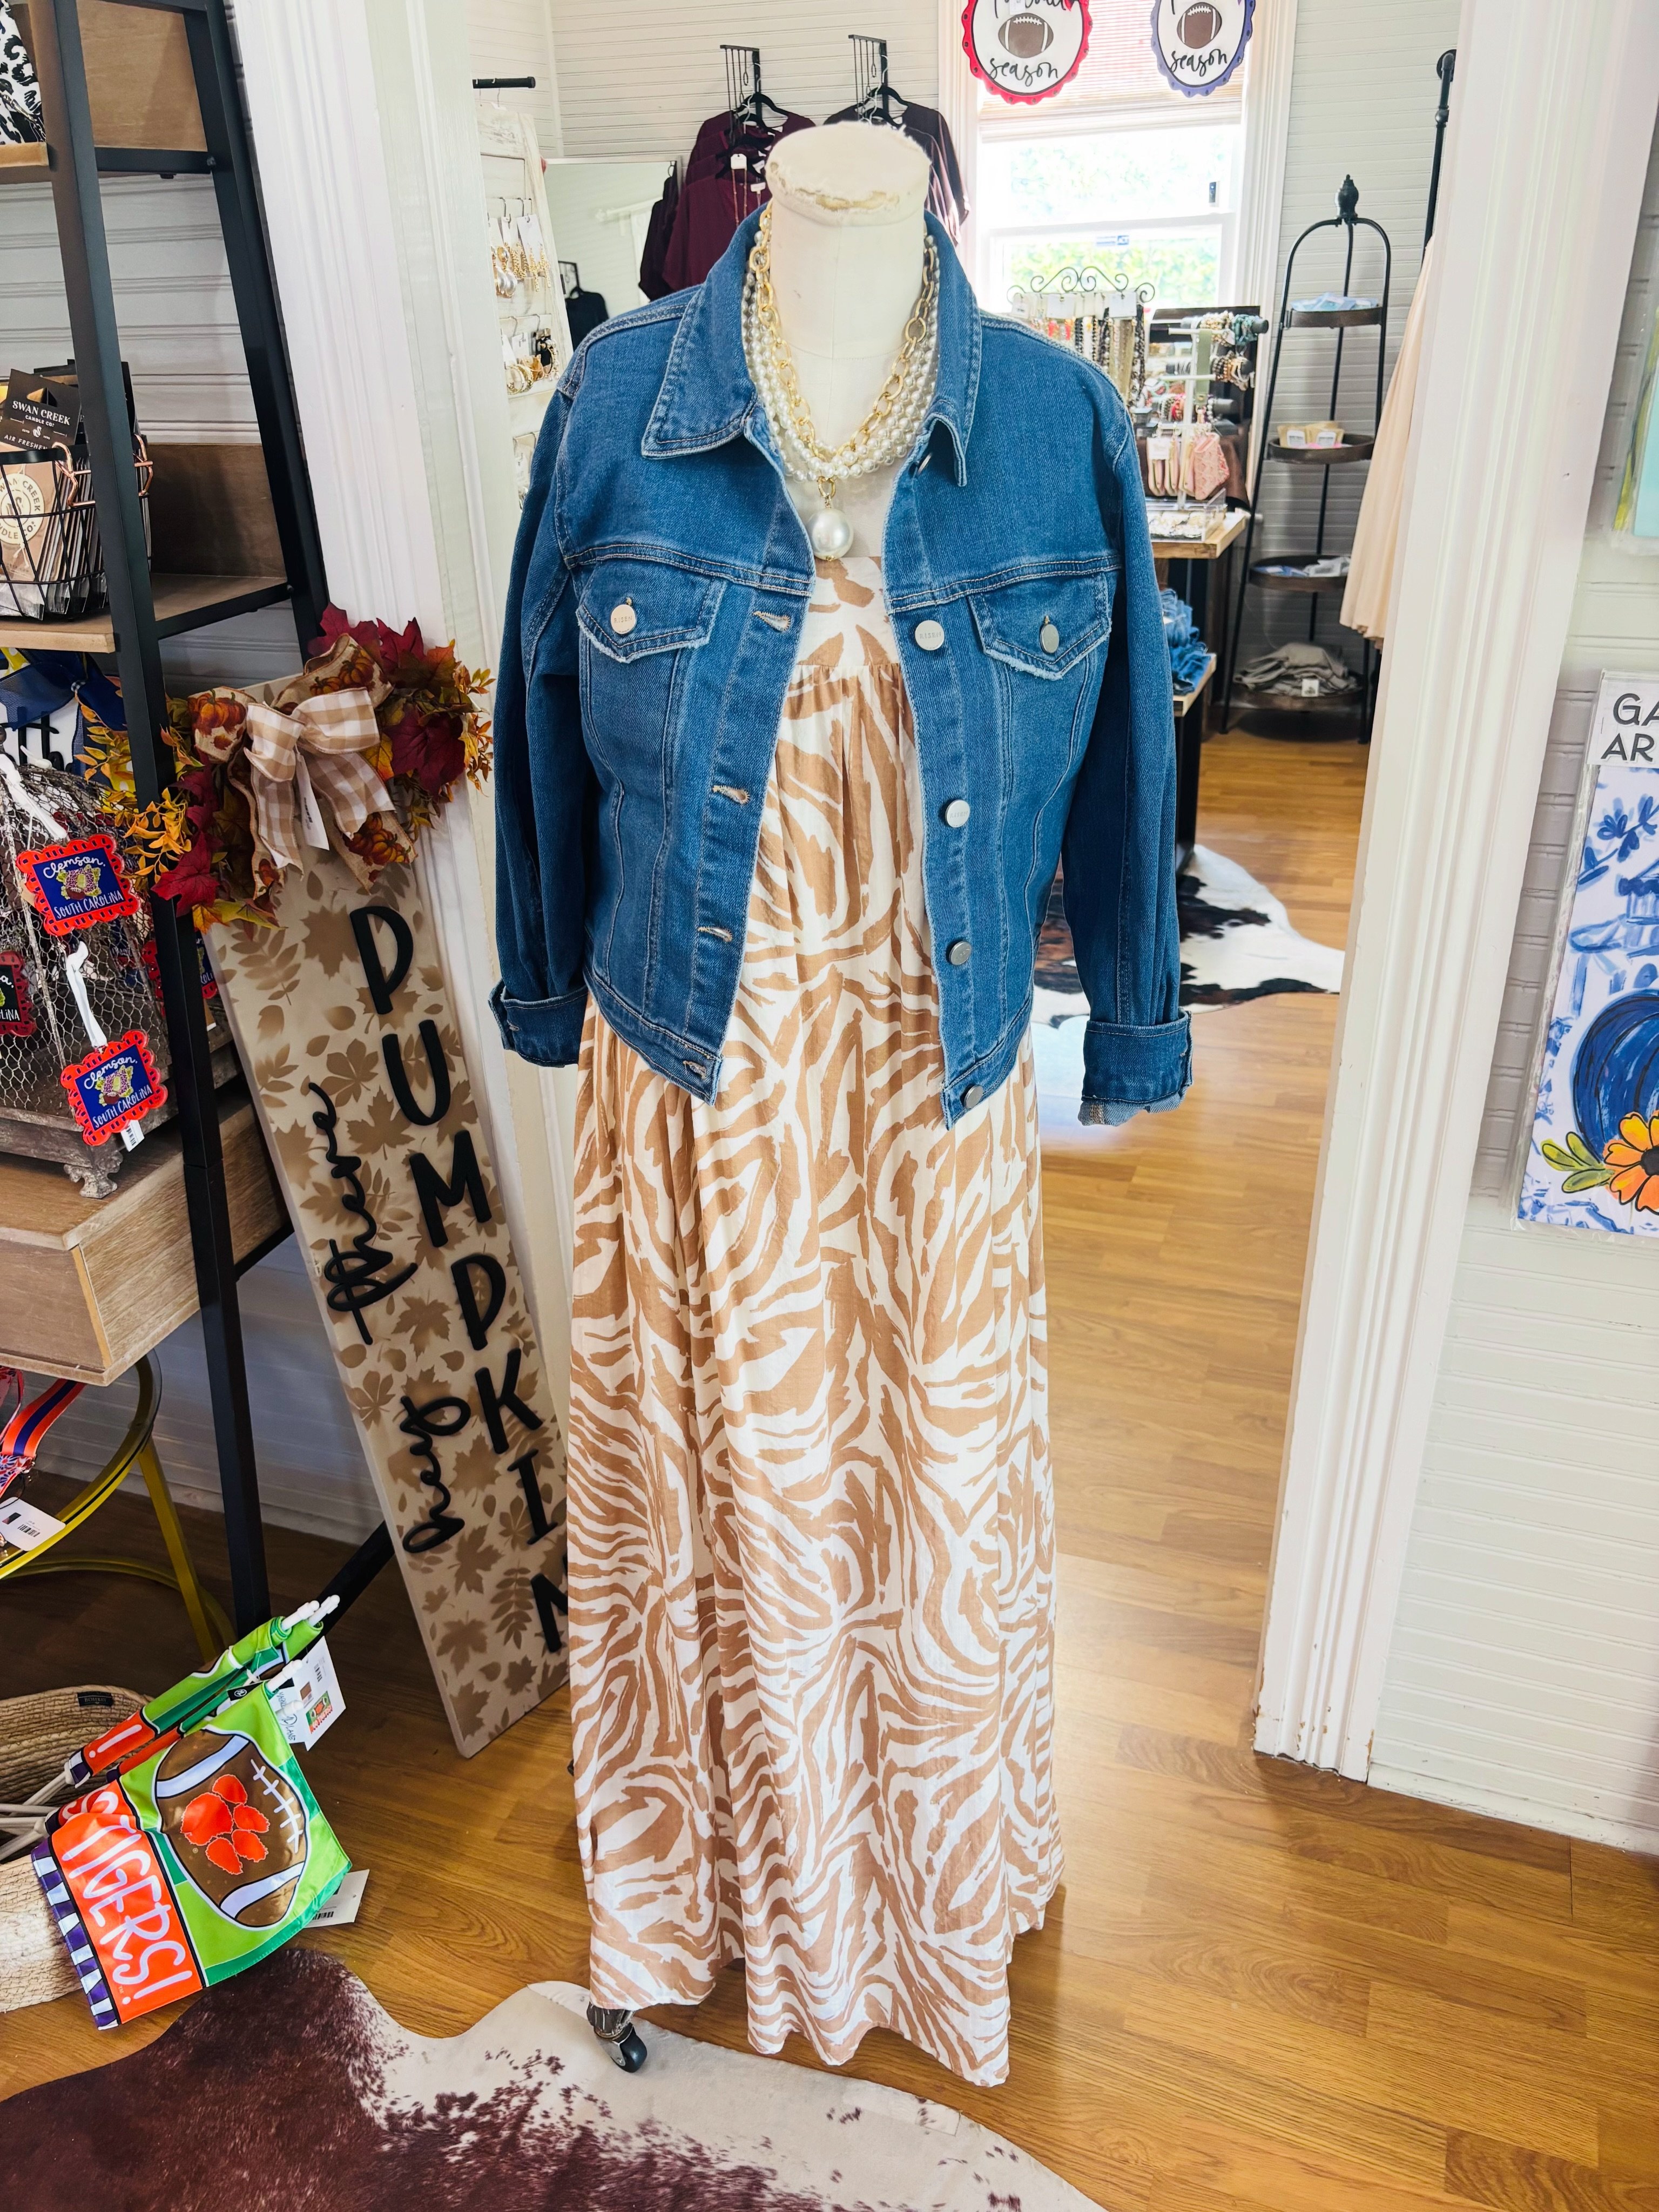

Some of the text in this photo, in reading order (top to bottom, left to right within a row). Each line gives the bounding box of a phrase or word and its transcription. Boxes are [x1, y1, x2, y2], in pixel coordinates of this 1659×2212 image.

[989, 57, 1058, 86] season
[1169, 48, 1228, 76] season
[12, 401, 39, 415] SWAN
[41, 409, 71, 426] CREEK
[25, 415, 44, 425] CANDLE
[22, 480, 41, 511] CREEK
[54, 902, 84, 919] SOUTH
[92, 1106, 118, 1128] SOUTH
[309, 1081, 471, 1554] hey there
[285, 1725, 295, 1741] LANE
[62, 1815, 193, 2005] TIGERS!
